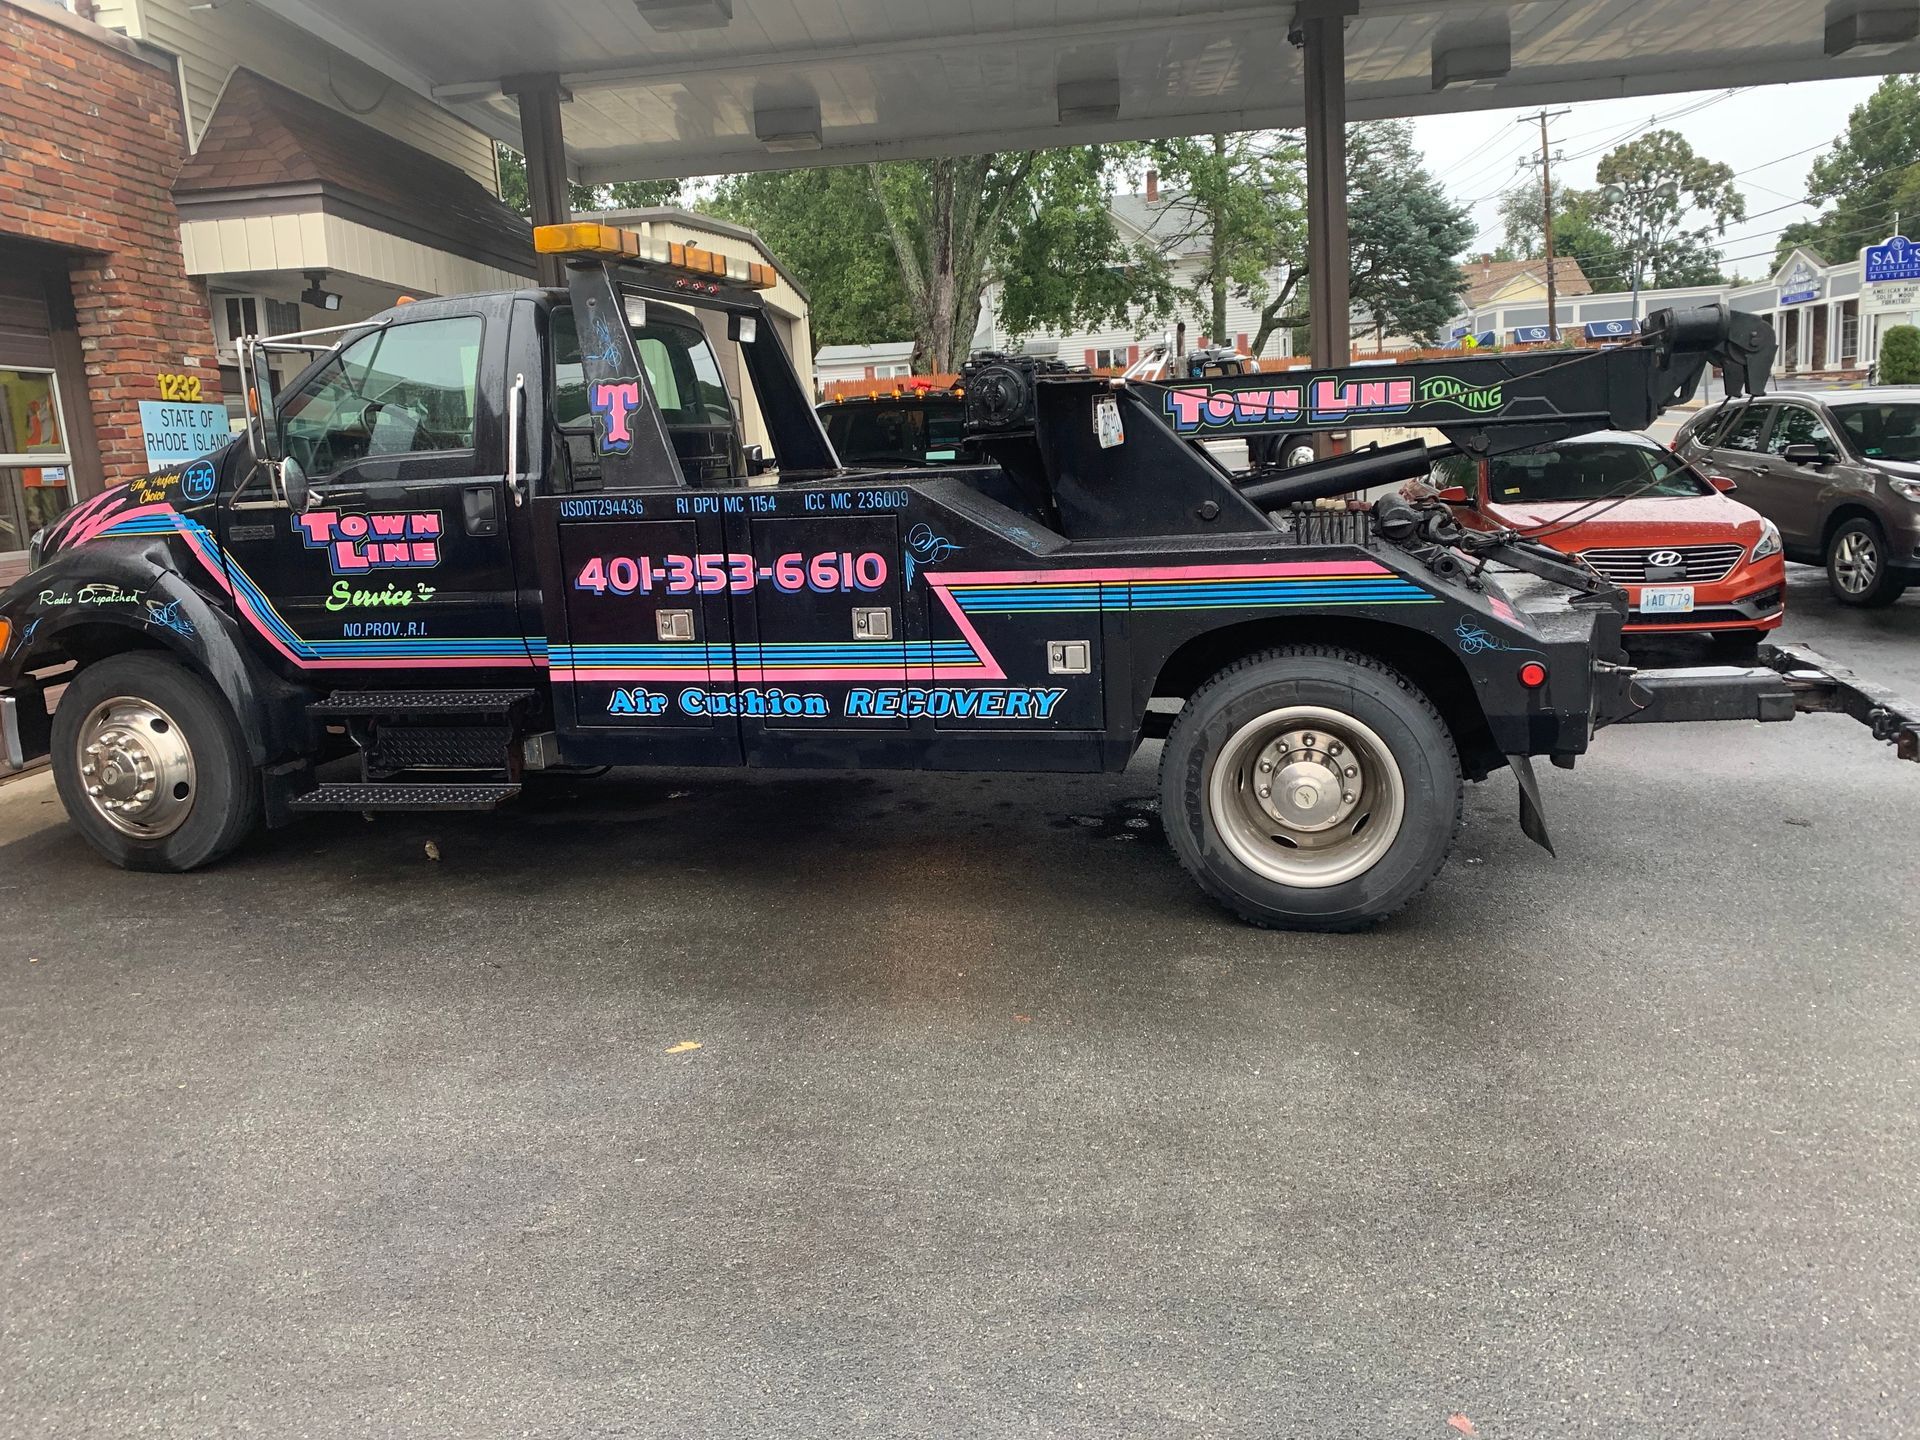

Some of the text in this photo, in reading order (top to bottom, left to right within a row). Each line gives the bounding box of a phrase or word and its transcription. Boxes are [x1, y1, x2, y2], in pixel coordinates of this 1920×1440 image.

[158, 373, 203, 401] 1232
[592, 382, 638, 451] T
[1167, 387, 1300, 431] TOWN
[1311, 380, 1413, 421] LINE
[1420, 380, 1502, 409] TOWING
[161, 408, 213, 428] STATE OF
[146, 432, 230, 452] RHODE ISLAND
[130, 478, 147, 492] The
[187, 468, 213, 493] T-26
[140, 488, 166, 504] Choice
[676, 495, 776, 514] RI DPU MC 1154
[804, 490, 909, 510] ICC MC 236009
[560, 499, 644, 517] USDOT294436
[293, 511, 441, 547] TOWN
[329, 541, 438, 575] LINE
[574, 551, 887, 596] 401-353-6610
[38, 588, 147, 606] Radio Dispatched
[325, 580, 413, 611] Service
[1670, 593, 1690, 606] 779
[607, 687, 1066, 718] Air Cushion RECOVERY
